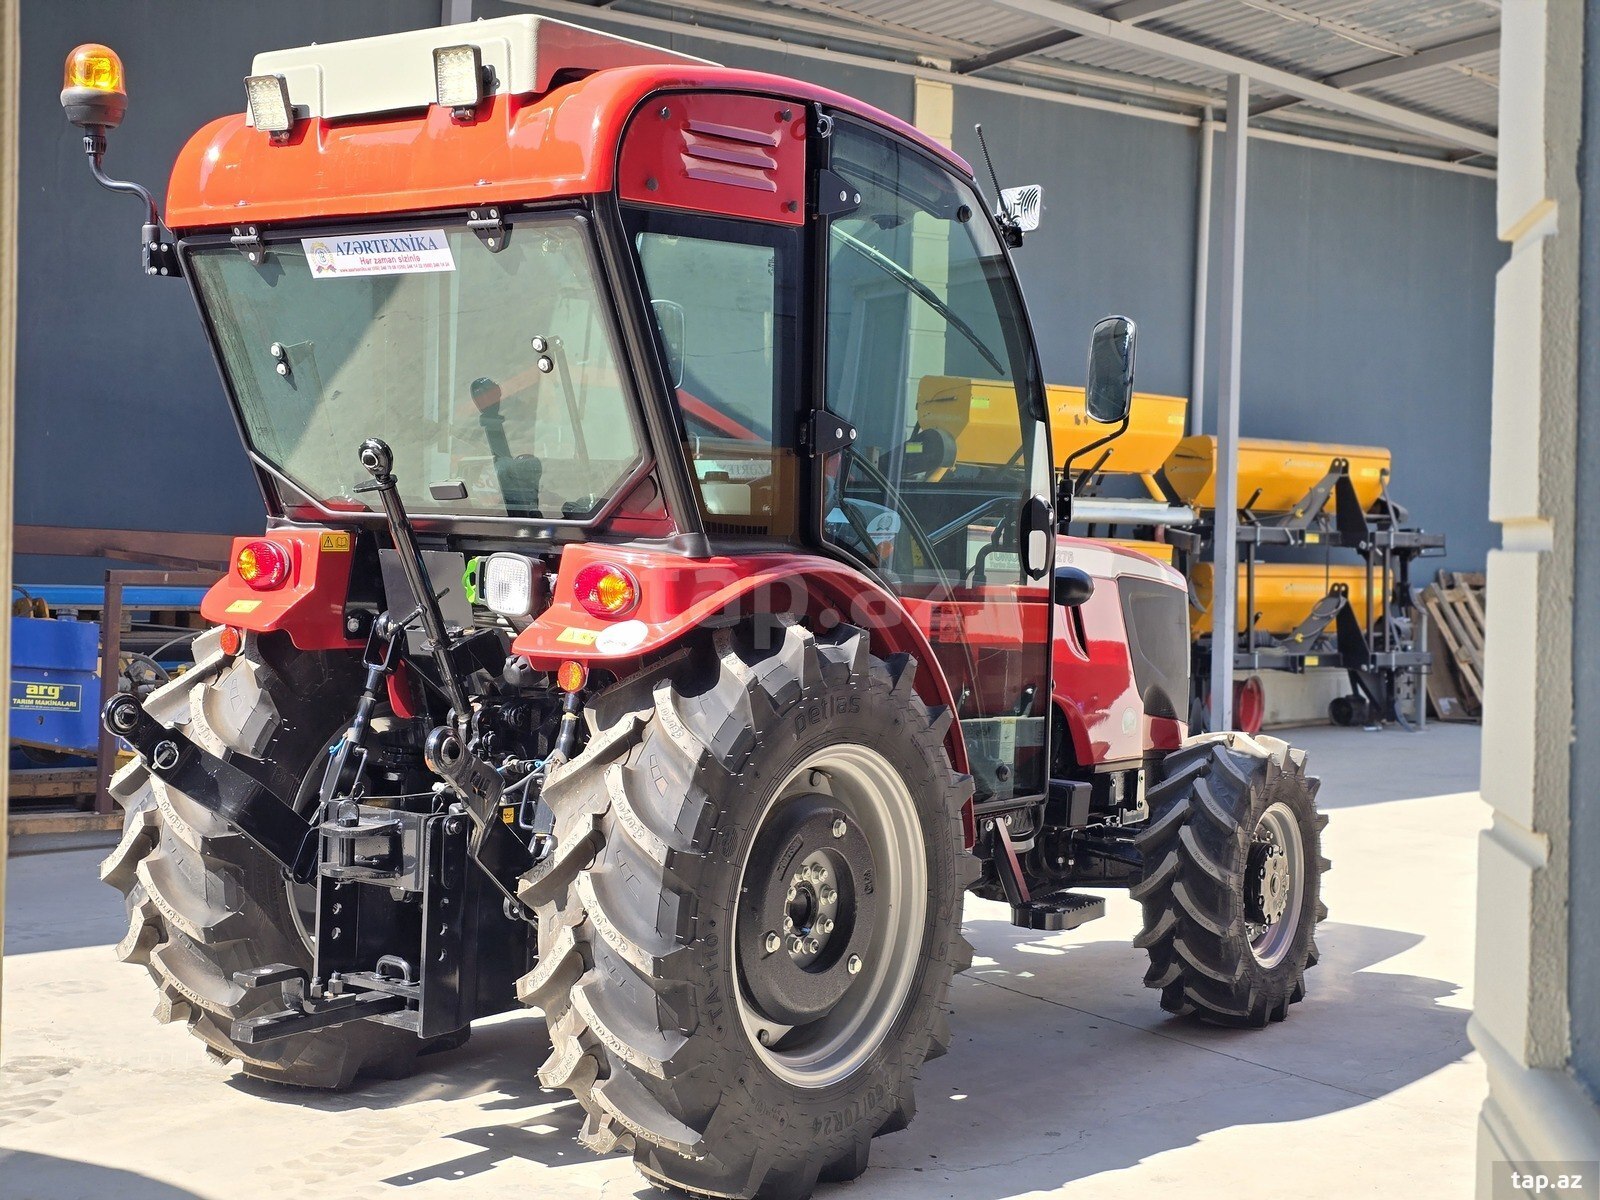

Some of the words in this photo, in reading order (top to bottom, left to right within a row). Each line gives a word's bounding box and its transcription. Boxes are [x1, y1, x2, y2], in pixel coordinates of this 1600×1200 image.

[336, 234, 438, 256] AZƏRTEXNİKA
[26, 684, 60, 700] arg
[794, 694, 861, 741] petlas
